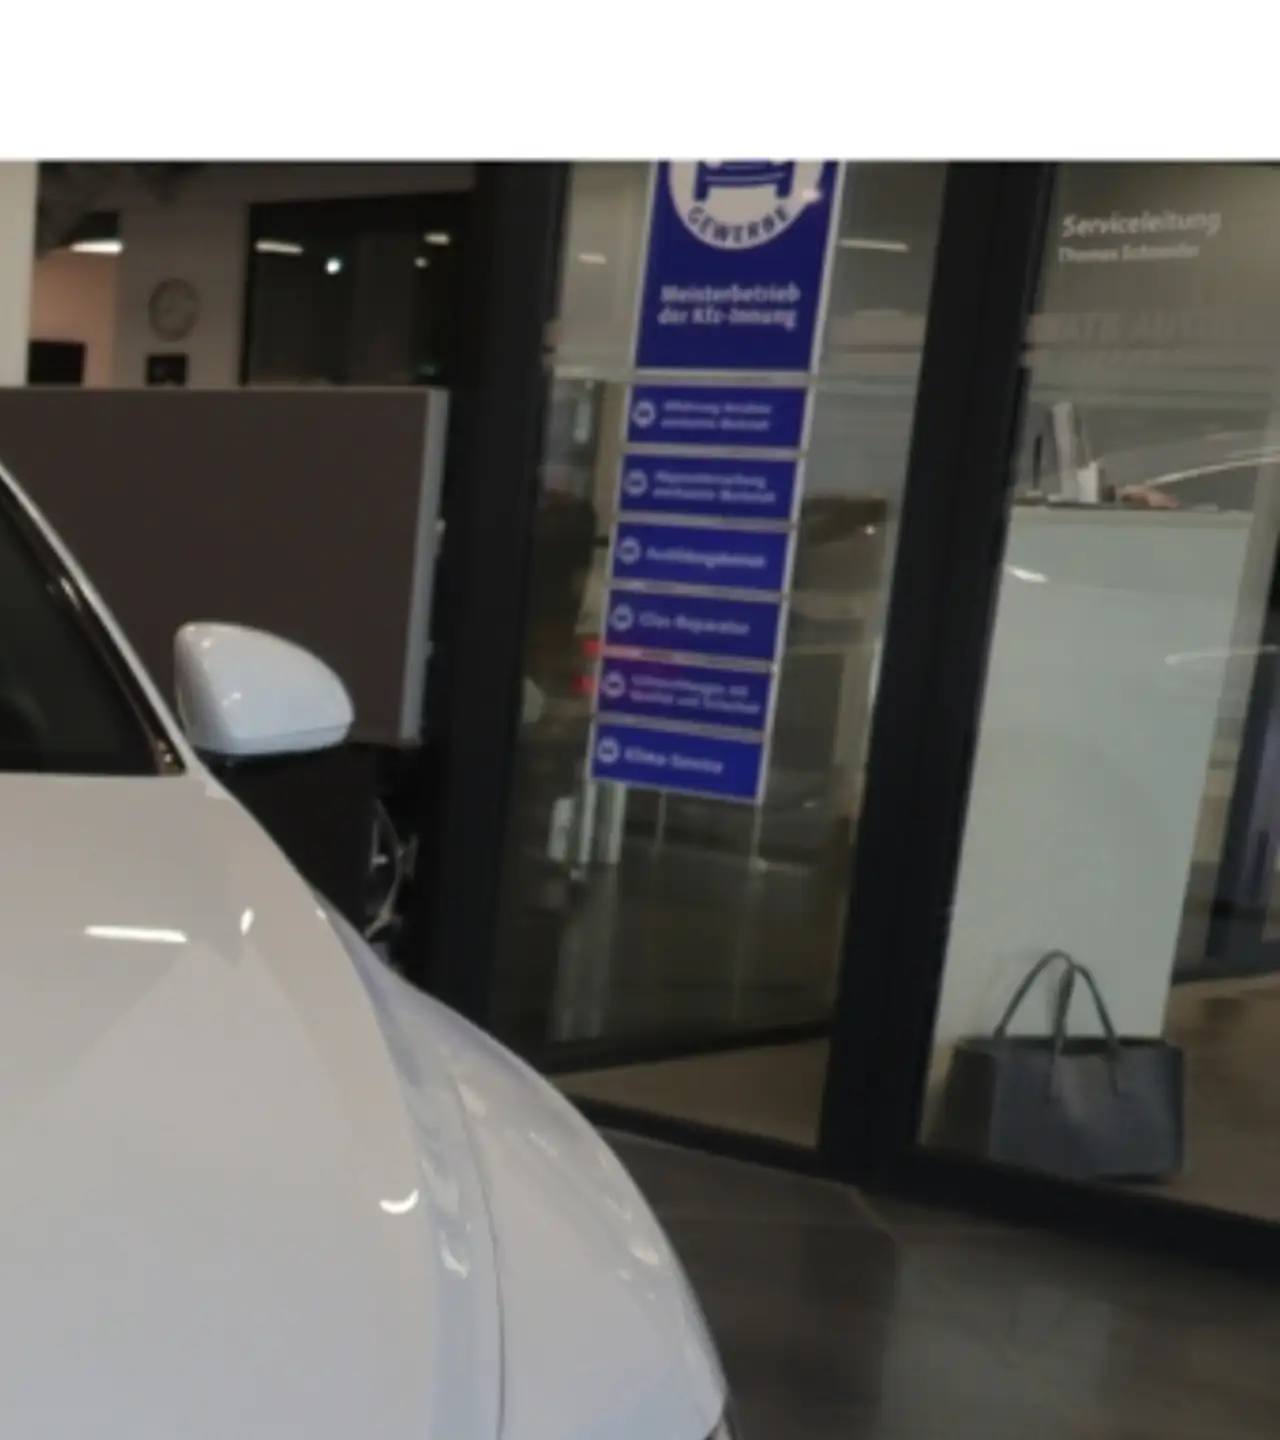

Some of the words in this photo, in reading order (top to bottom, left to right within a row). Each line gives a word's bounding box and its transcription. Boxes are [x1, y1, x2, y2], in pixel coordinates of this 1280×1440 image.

[687, 204, 790, 245] GEWERBE
[1061, 209, 1222, 238] Serviceleitung
[660, 281, 802, 304] Meisterbetrieb
[657, 305, 688, 324] der
[692, 307, 798, 331] Kfz-Innung
